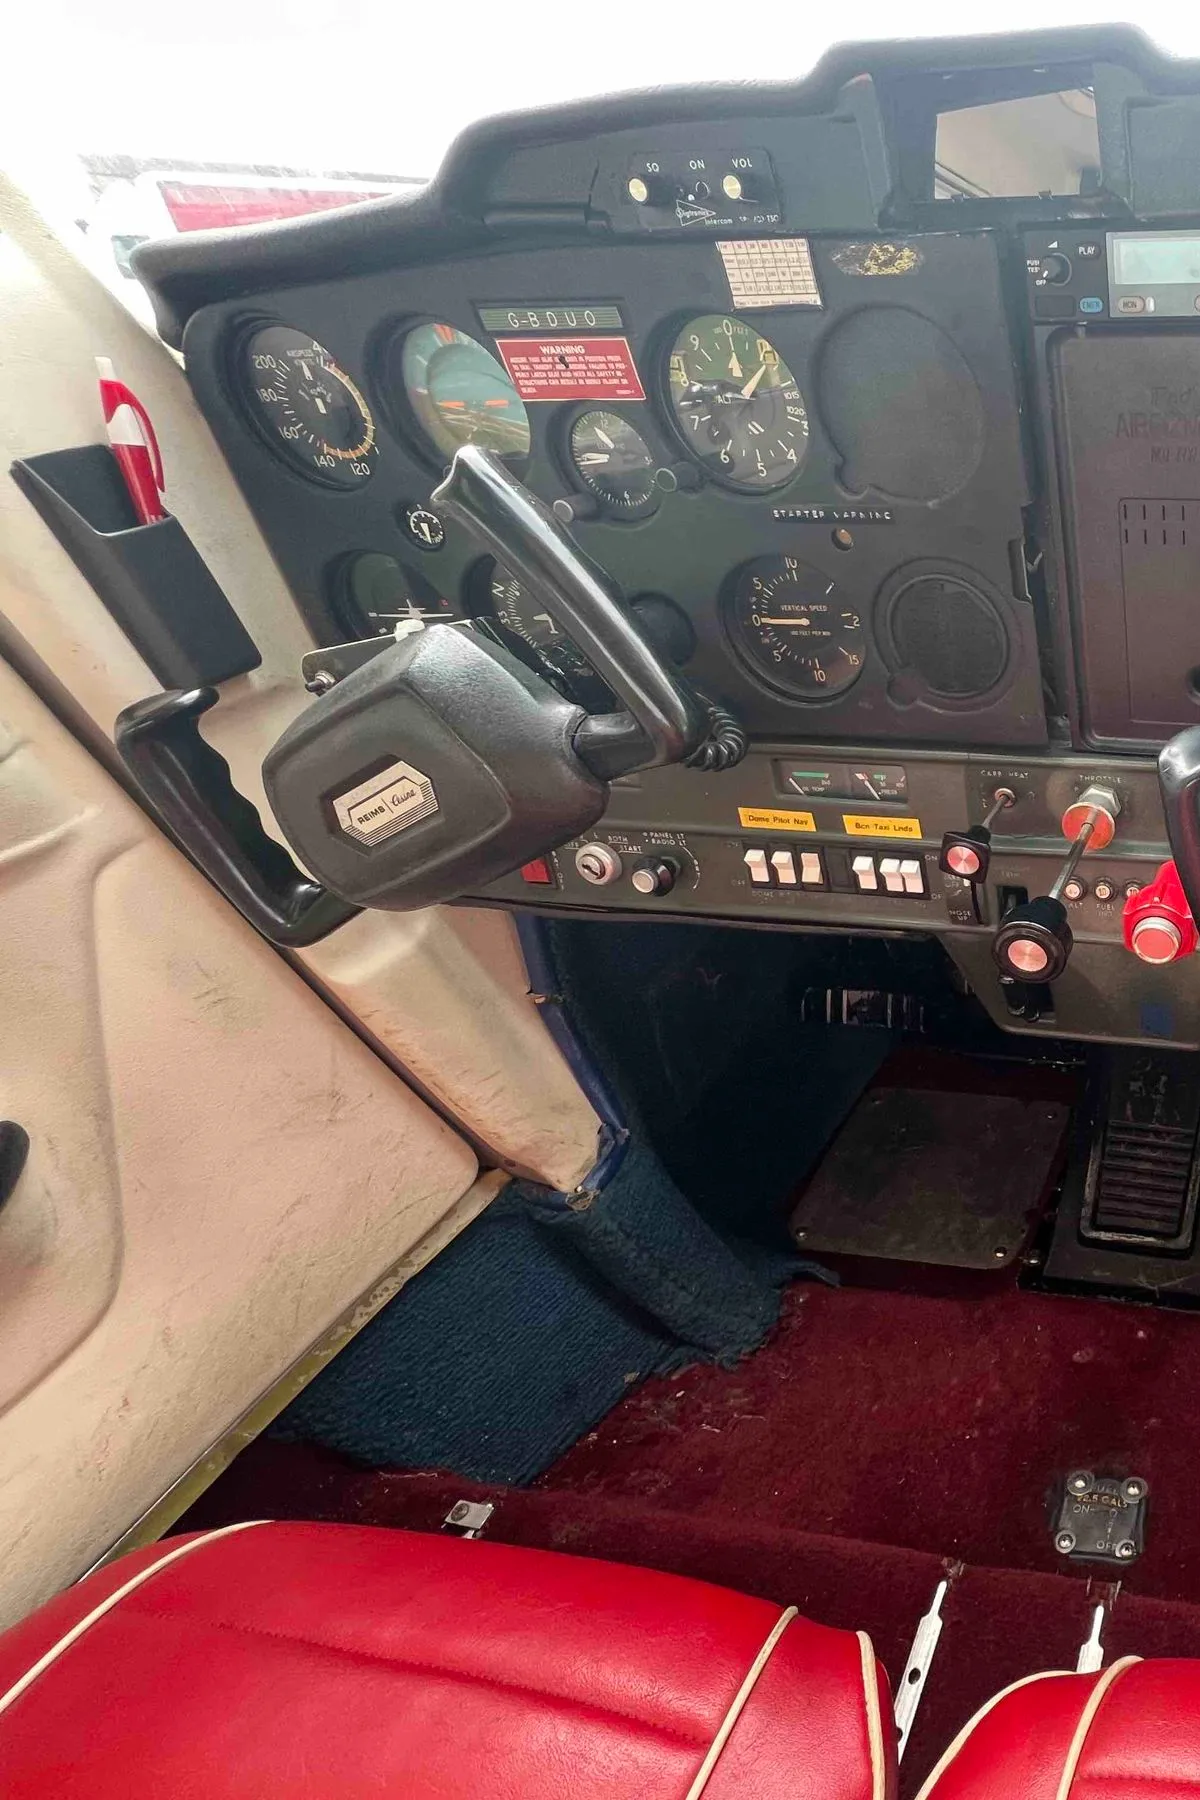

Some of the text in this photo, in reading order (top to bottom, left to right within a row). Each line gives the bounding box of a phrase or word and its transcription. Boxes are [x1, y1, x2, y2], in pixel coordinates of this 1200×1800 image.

[646, 162, 660, 173] SQ
[689, 159, 705, 170] ON
[732, 158, 753, 169] VOL
[1078, 246, 1096, 256] PLAY
[722, 319, 733, 336] 0
[690, 334, 700, 351] 9
[539, 344, 586, 355] WARNING
[254, 354, 277, 369] 200
[256, 388, 276, 402] 180
[690, 415, 700, 431] 7
[278, 426, 299, 440] 160
[314, 455, 336, 468] 140
[719, 449, 730, 464] 6
[786, 448, 798, 464] 4
[350, 463, 370, 475] 120
[757, 462, 767, 478] 5
[772, 508, 826, 519] STARTER
[491, 581, 505, 598] N
[752, 576, 762, 590] 5
[780, 604, 828, 612] VERTICAL SPEED
[751, 613, 761, 627] 0
[852, 615, 861, 628] 2
[773, 649, 782, 663] 5
[849, 653, 860, 666] 15
[814, 669, 827, 682] 10
[356, 805, 386, 825] REIMS
[747, 814, 810, 826] Dome Pilot Nav
[854, 821, 871, 831] Bcn
[874, 823, 891, 832] Taxi
[649, 831, 686, 840] PANEL LT
[651, 838, 676, 846] RADIO
[925, 854, 939, 862] ON
[1096, 903, 1116, 913] FUEL
[1072, 1503, 1091, 1514] ON
